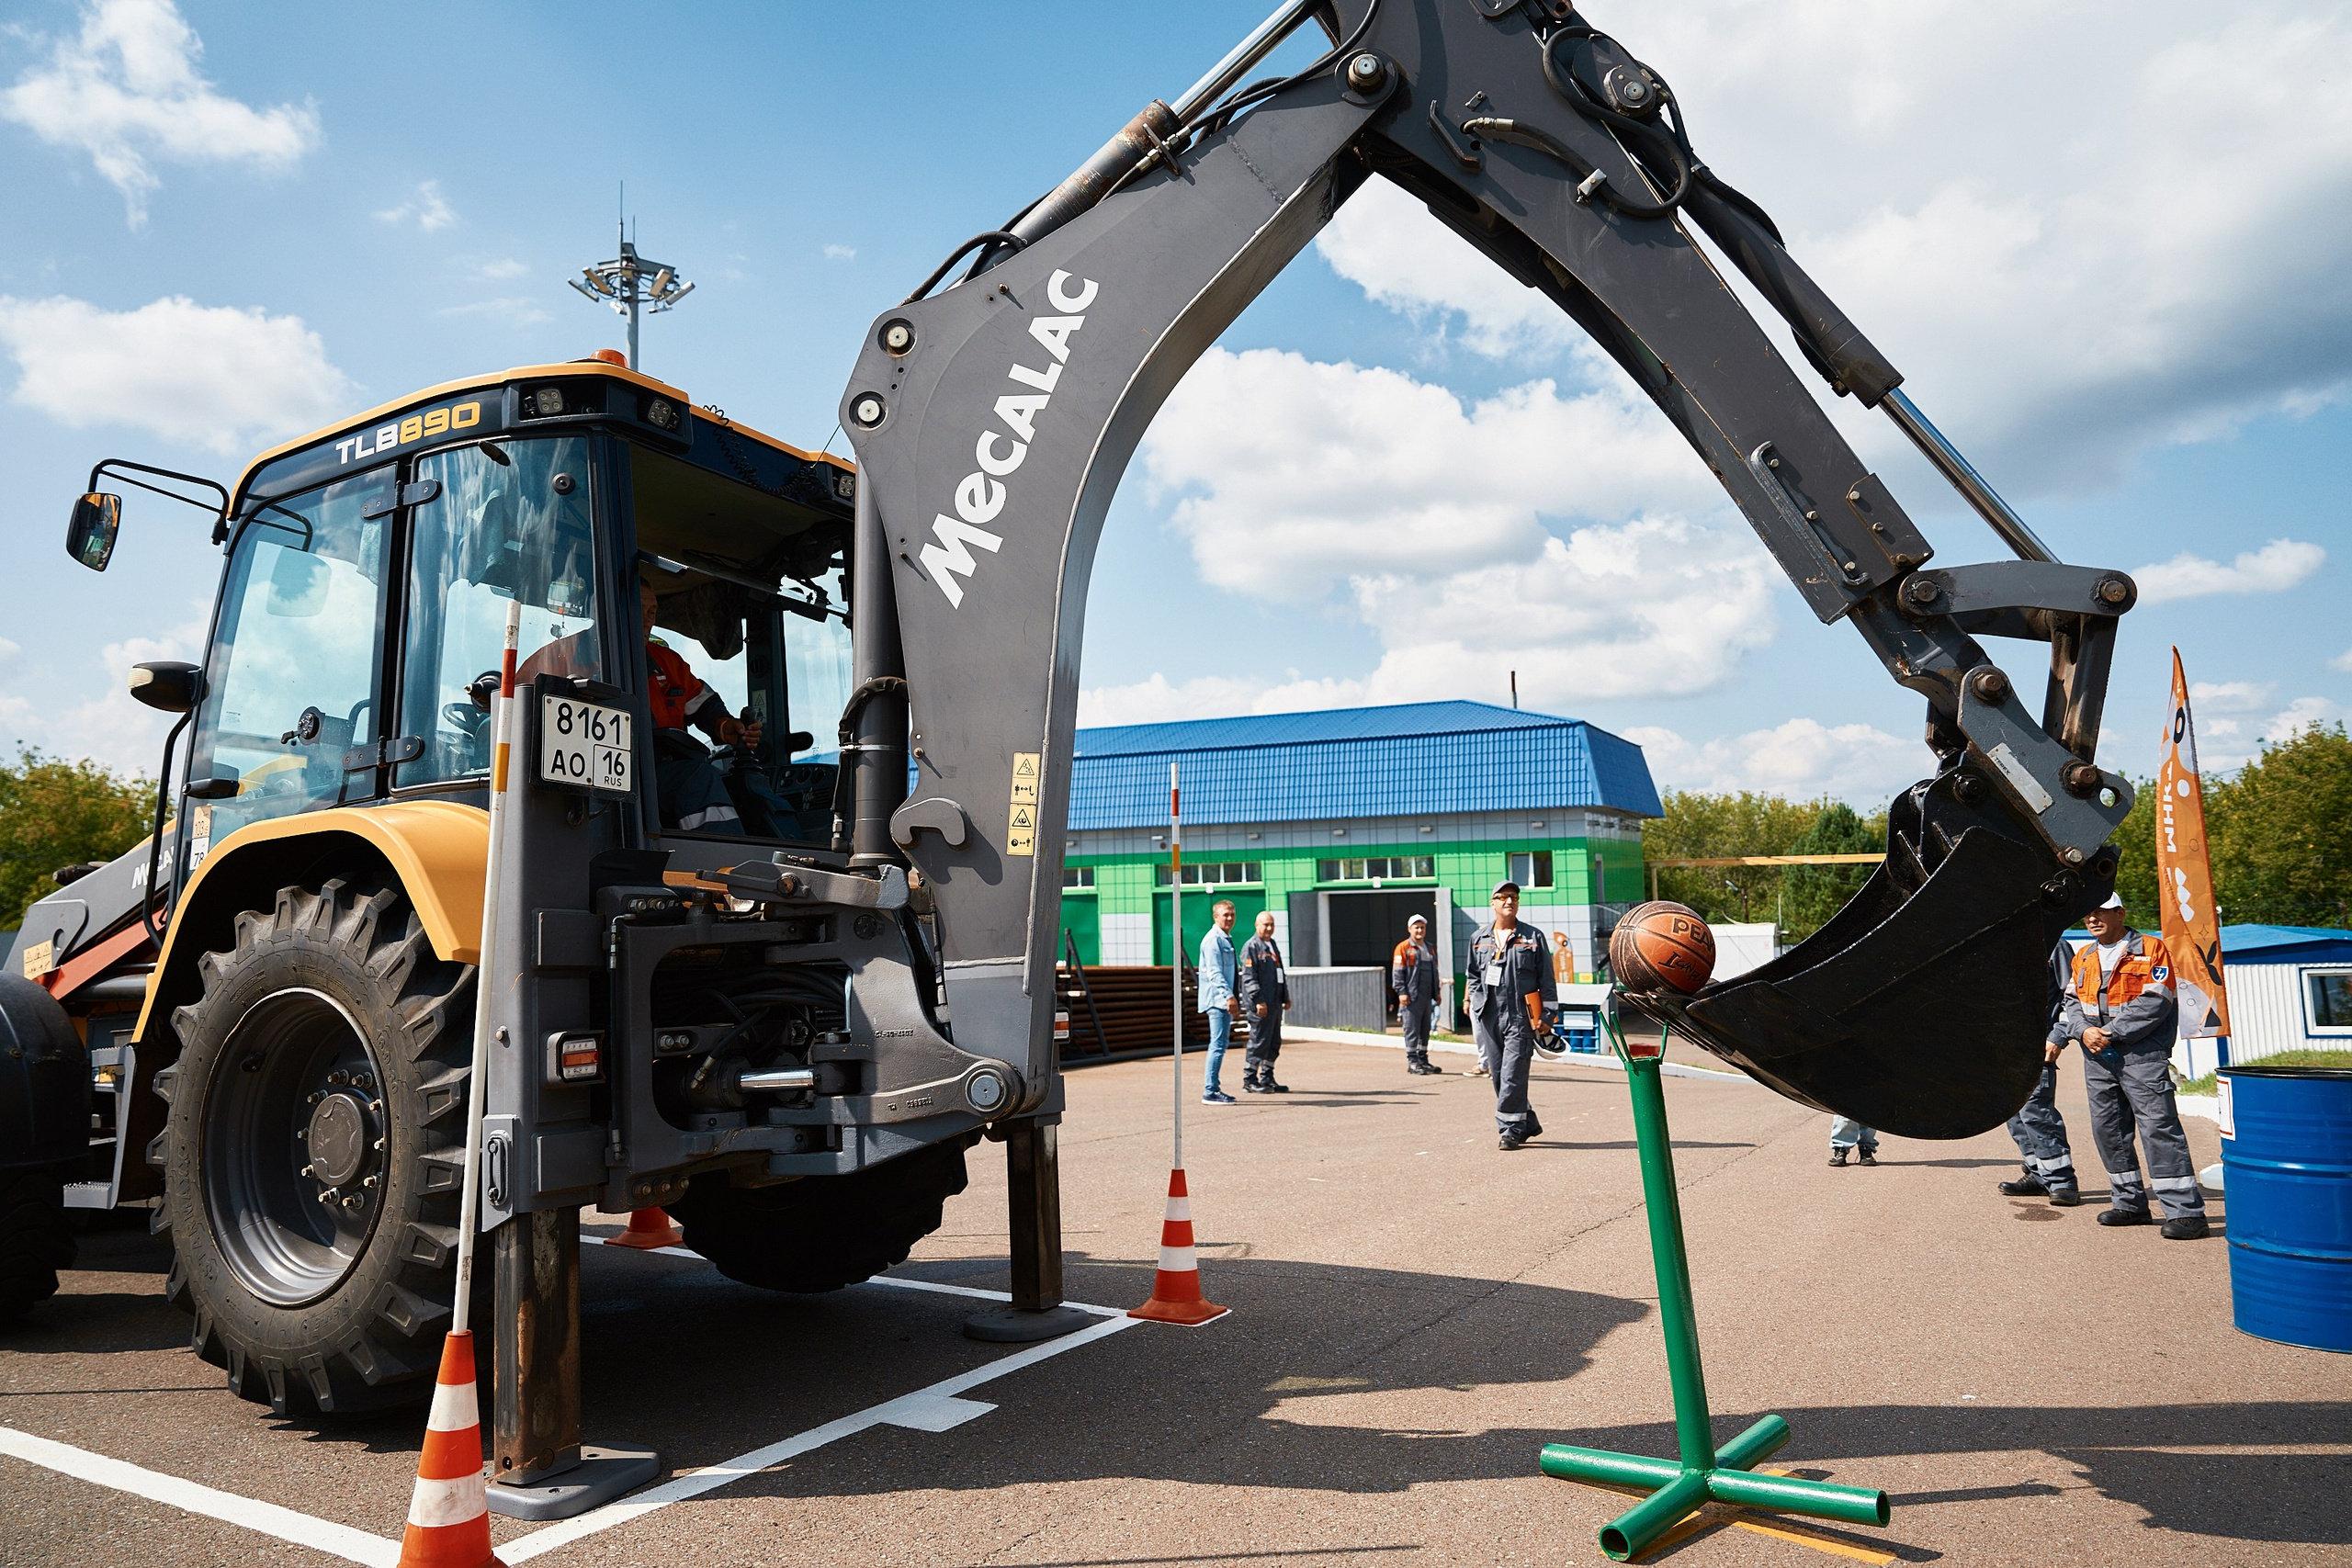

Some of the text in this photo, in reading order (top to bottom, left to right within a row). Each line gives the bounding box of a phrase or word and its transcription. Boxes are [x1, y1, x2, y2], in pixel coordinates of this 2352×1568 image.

[335, 401, 481, 465] TLB890
[557, 702, 620, 745] 8161
[603, 750, 625, 776] 16
[604, 775, 622, 787] RUS
[177, 1152, 214, 1275] STARMAXX
